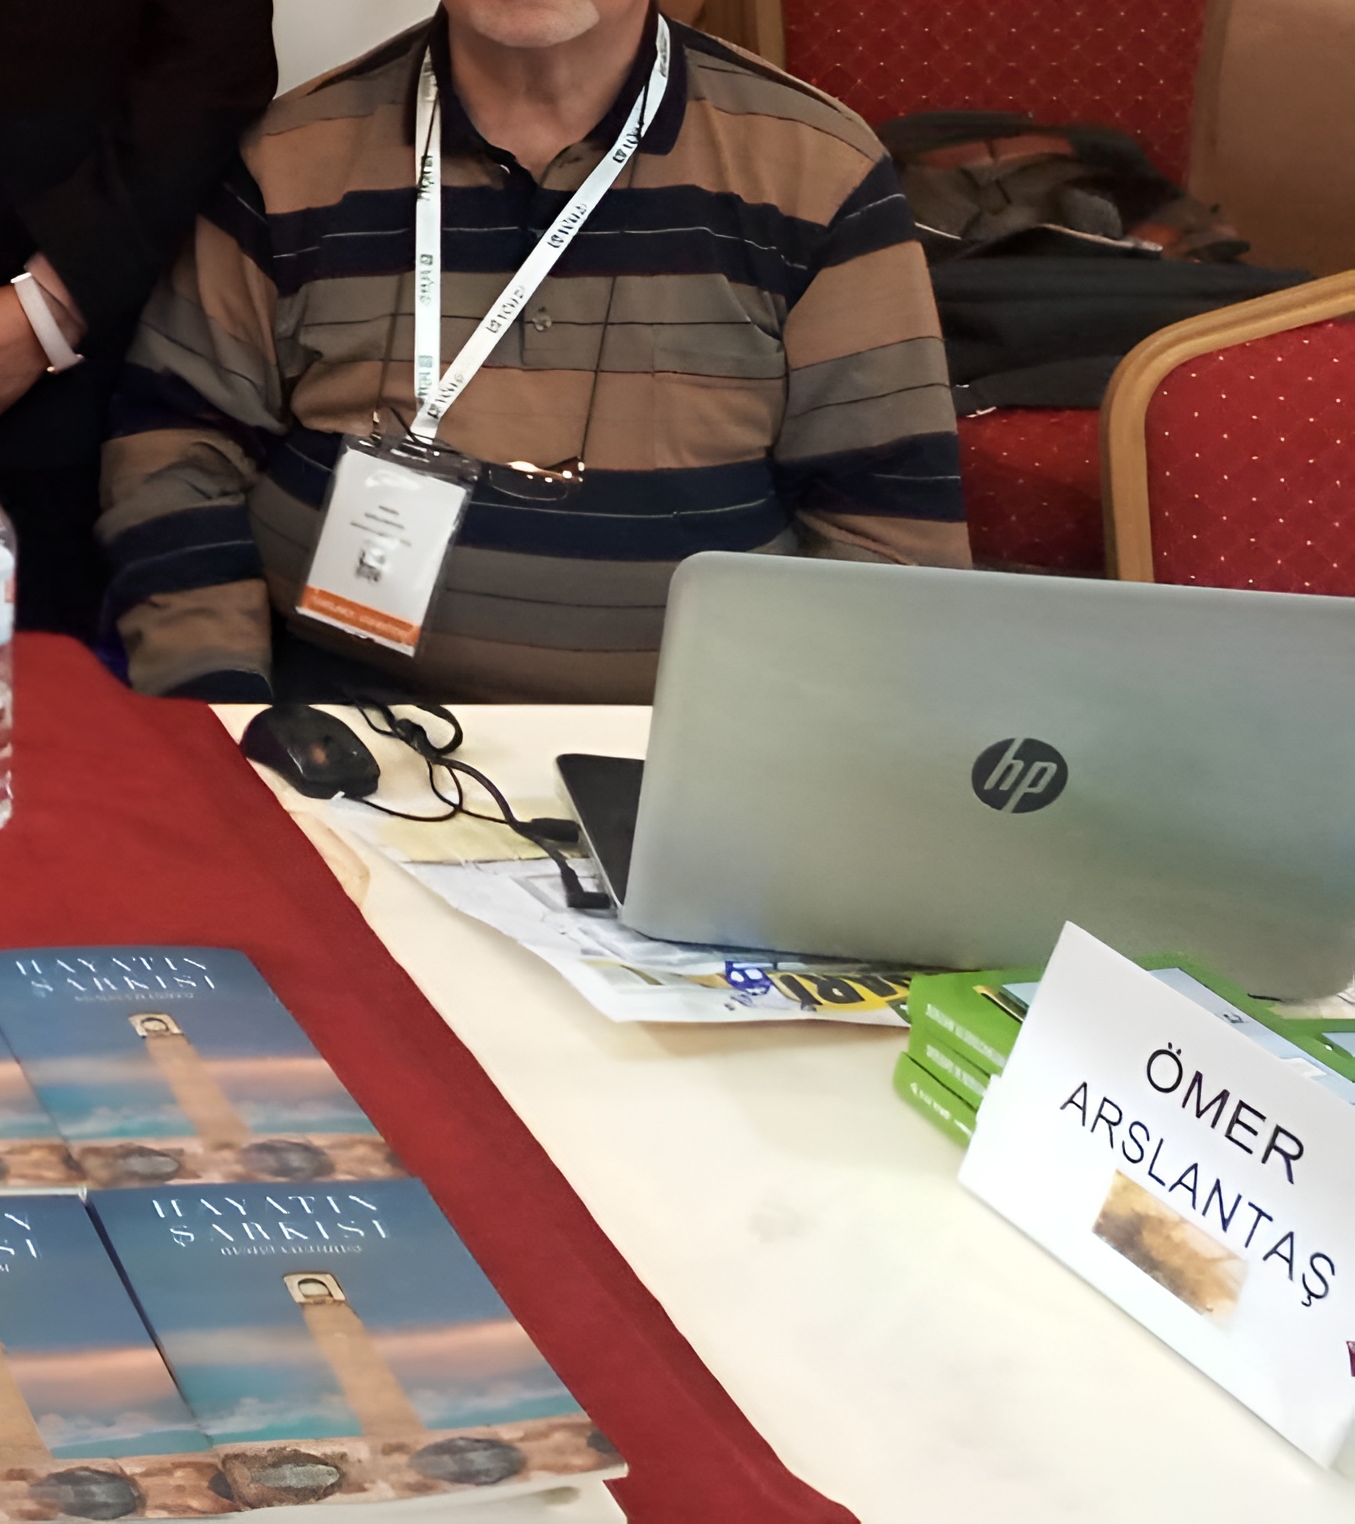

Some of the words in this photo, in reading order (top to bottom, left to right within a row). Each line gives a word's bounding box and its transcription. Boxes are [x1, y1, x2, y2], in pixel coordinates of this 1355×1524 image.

[983, 738, 1058, 814] hp
[1146, 1042, 1304, 1184] ÖMER
[1060, 1081, 1336, 1307] ARSLANTAŞ
